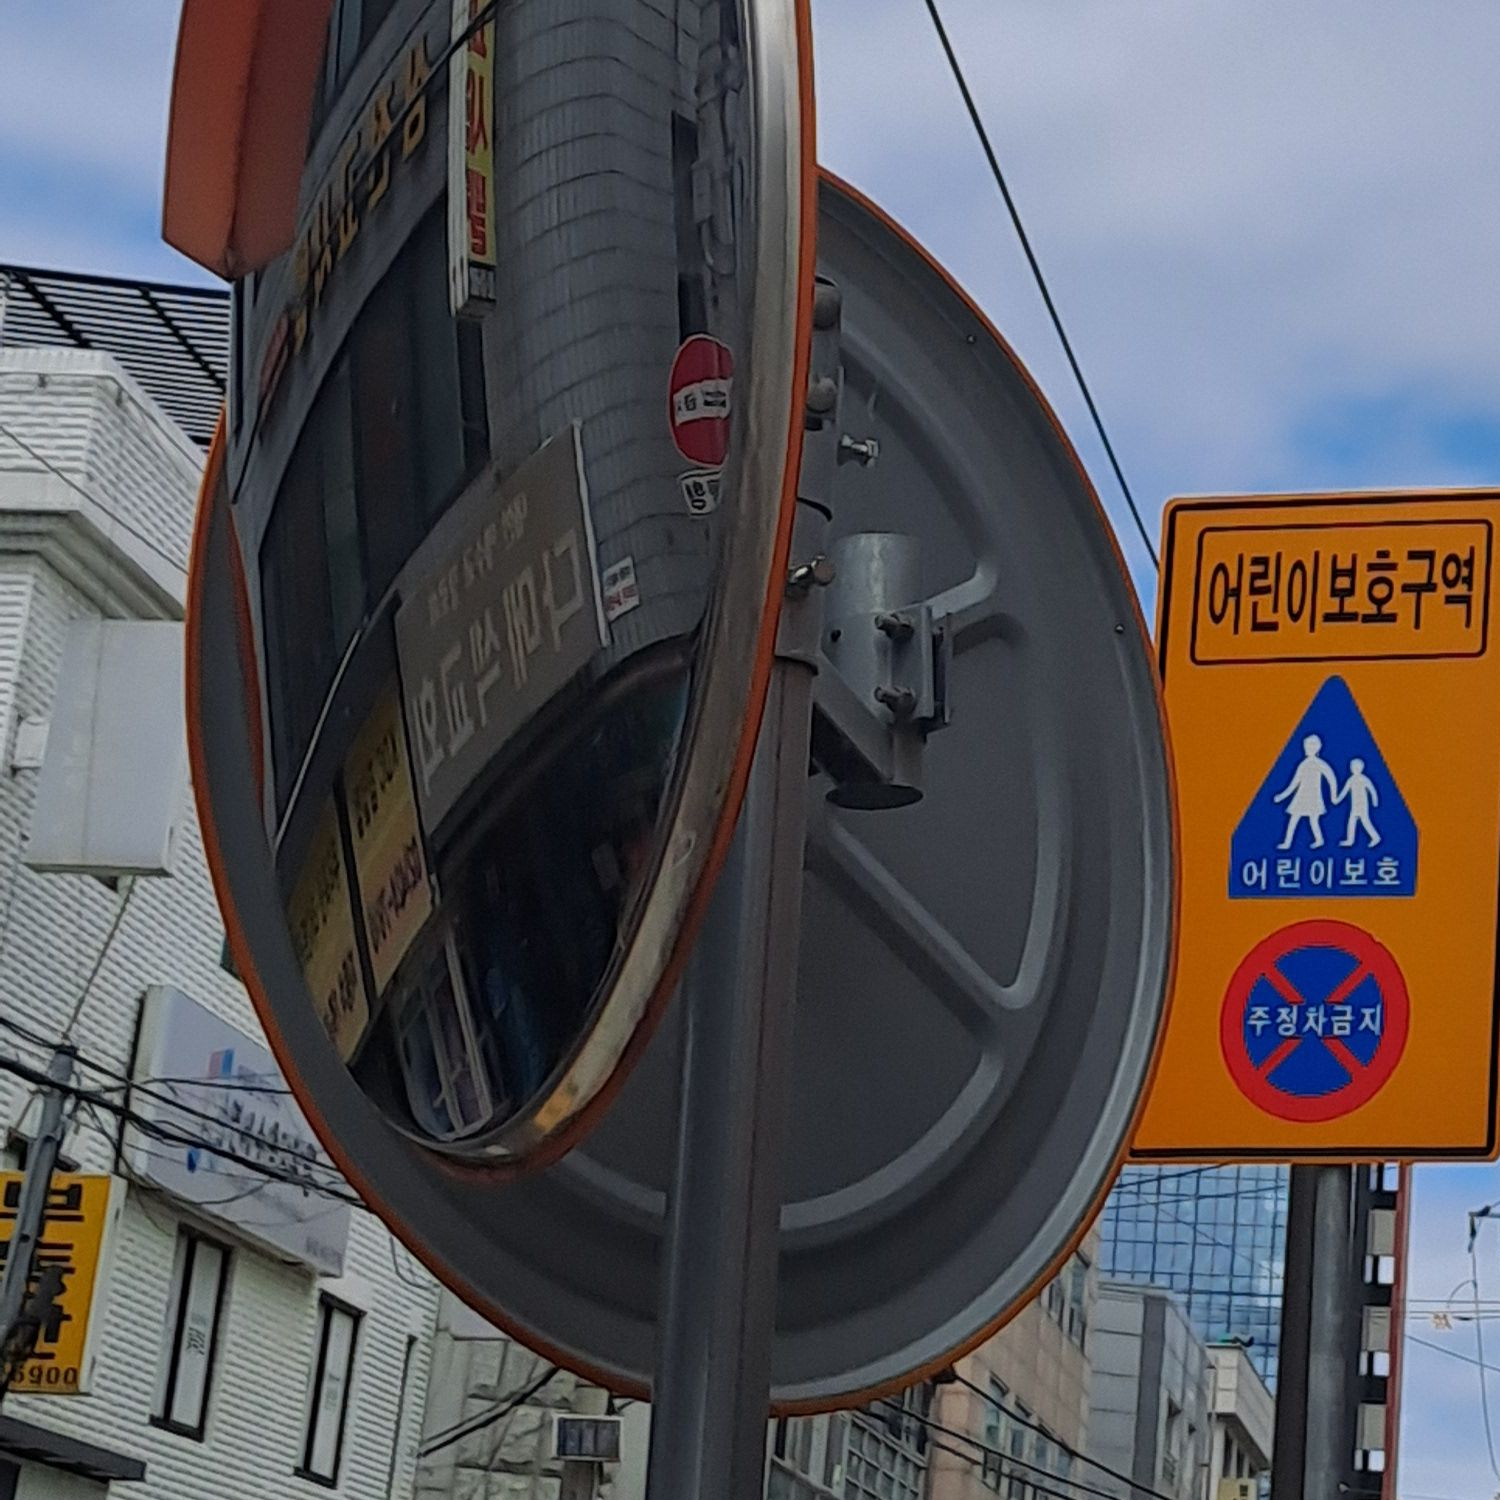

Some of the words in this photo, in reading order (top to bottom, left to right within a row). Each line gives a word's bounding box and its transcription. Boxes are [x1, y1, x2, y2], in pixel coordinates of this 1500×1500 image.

[1209, 545, 1475, 635] 어린이보호구역
[1243, 856, 1402, 890] 어린이보호
[1247, 1003, 1382, 1038] 주정차금지
